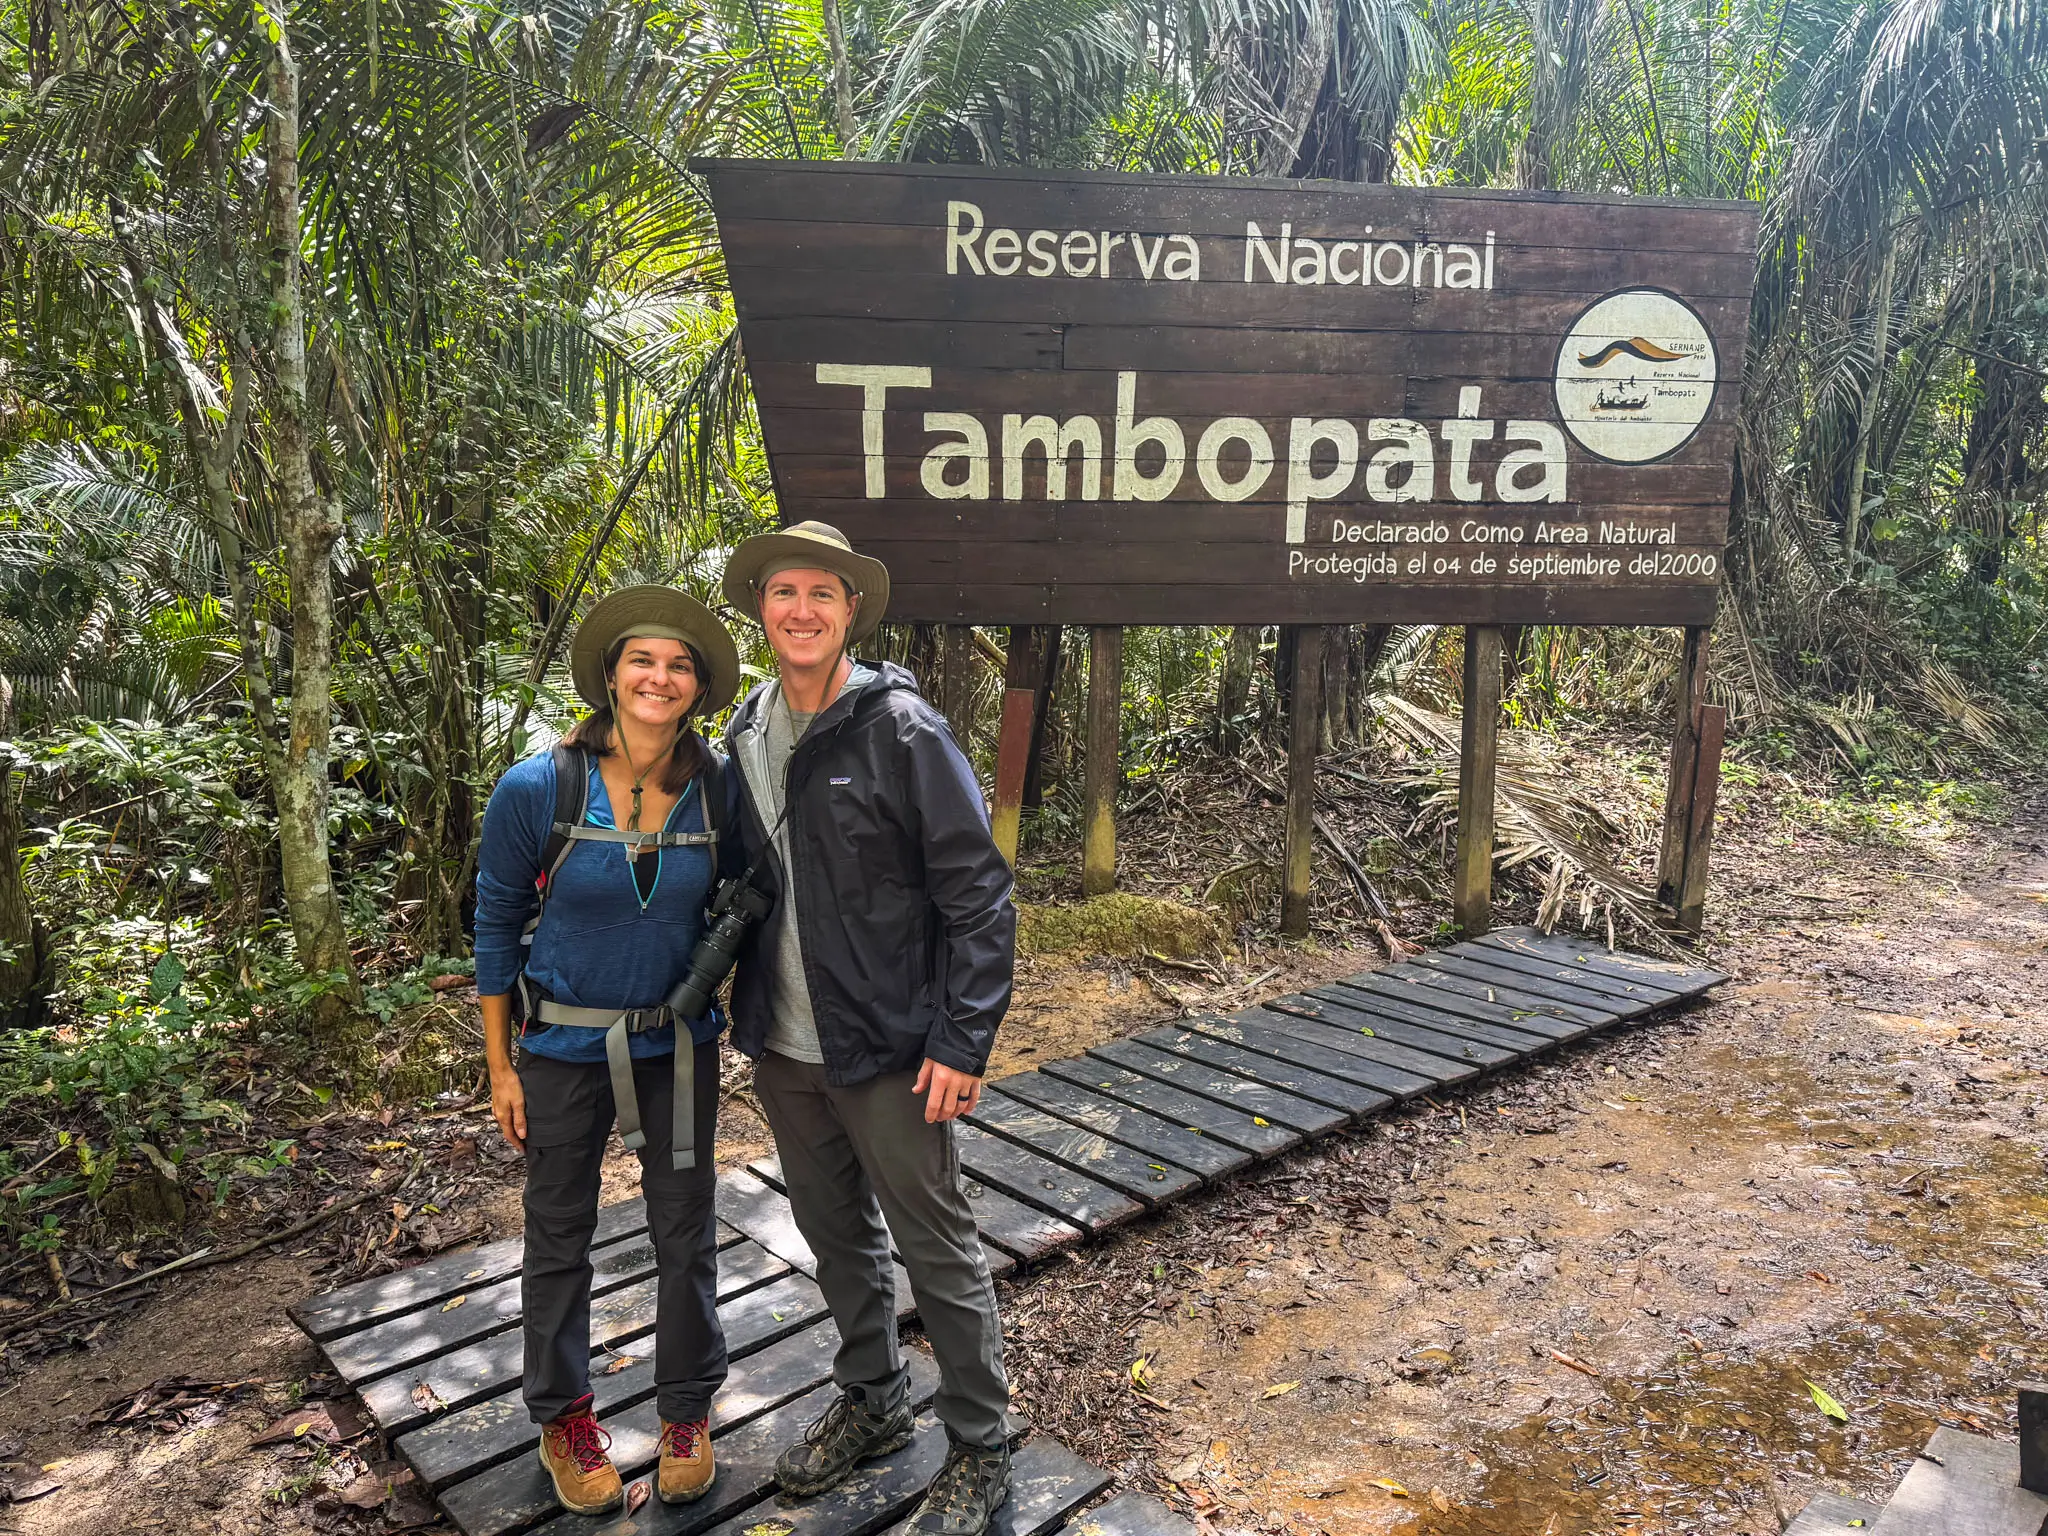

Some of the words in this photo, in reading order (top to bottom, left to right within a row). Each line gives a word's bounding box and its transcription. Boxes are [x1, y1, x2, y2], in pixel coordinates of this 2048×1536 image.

[945, 200, 1200, 282] Reserva
[1244, 221, 1496, 290] Nacional
[1652, 386, 1696, 398] Tambopata
[815, 363, 1568, 544] Tambopata
[1332, 519, 1449, 543] Declarado
[1461, 520, 1524, 543] Como
[1534, 521, 1589, 544] Area
[1600, 521, 1676, 545] Natural
[1288, 550, 1398, 583] Protegida
[1407, 551, 1427, 574] el
[1433, 557, 1462, 574] 04
[1470, 552, 1497, 575] de
[1507, 552, 1621, 580] septiembre
